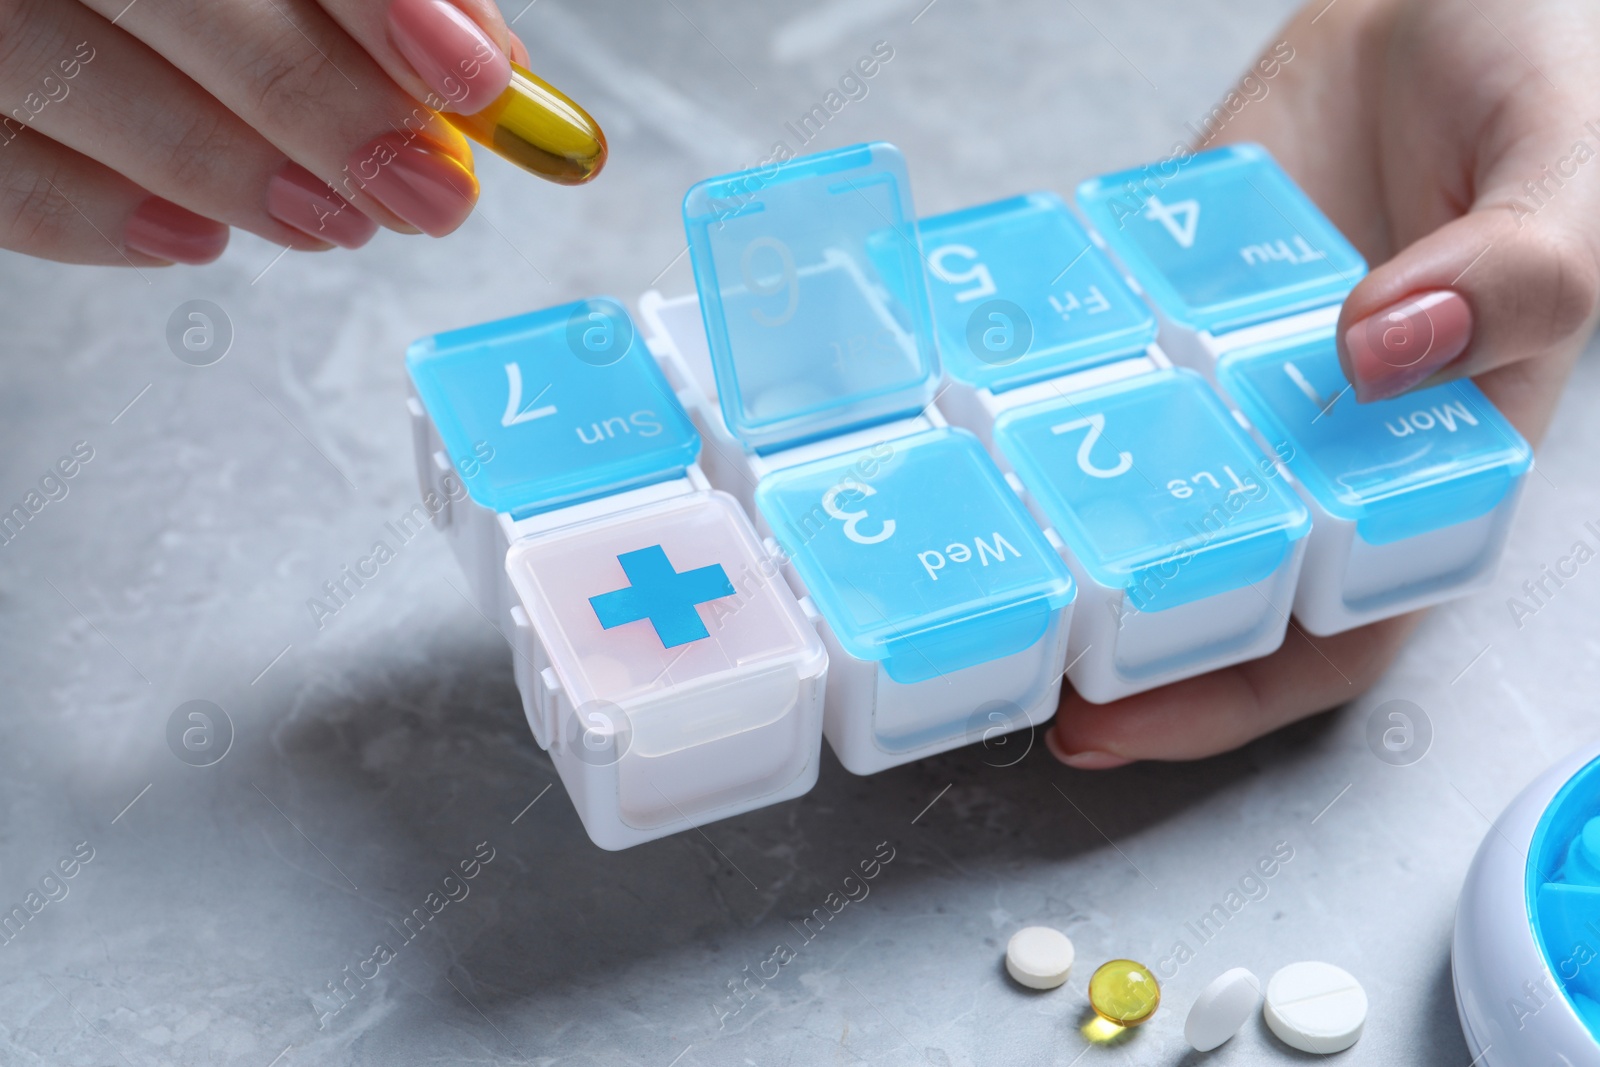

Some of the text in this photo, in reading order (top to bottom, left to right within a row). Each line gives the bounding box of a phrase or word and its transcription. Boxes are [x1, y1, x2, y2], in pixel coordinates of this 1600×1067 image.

[1145, 197, 1200, 248] 4
[928, 244, 997, 303] 5
[1240, 234, 1328, 266] Thu
[1048, 285, 1111, 321] Fri
[501, 362, 558, 428] 7
[1283, 361, 1340, 416] 1
[576, 410, 664, 444] Sun
[1385, 401, 1479, 437] Mon
[1051, 413, 1133, 479] 2
[822, 482, 896, 545] 3
[917, 532, 1022, 581] Wed
